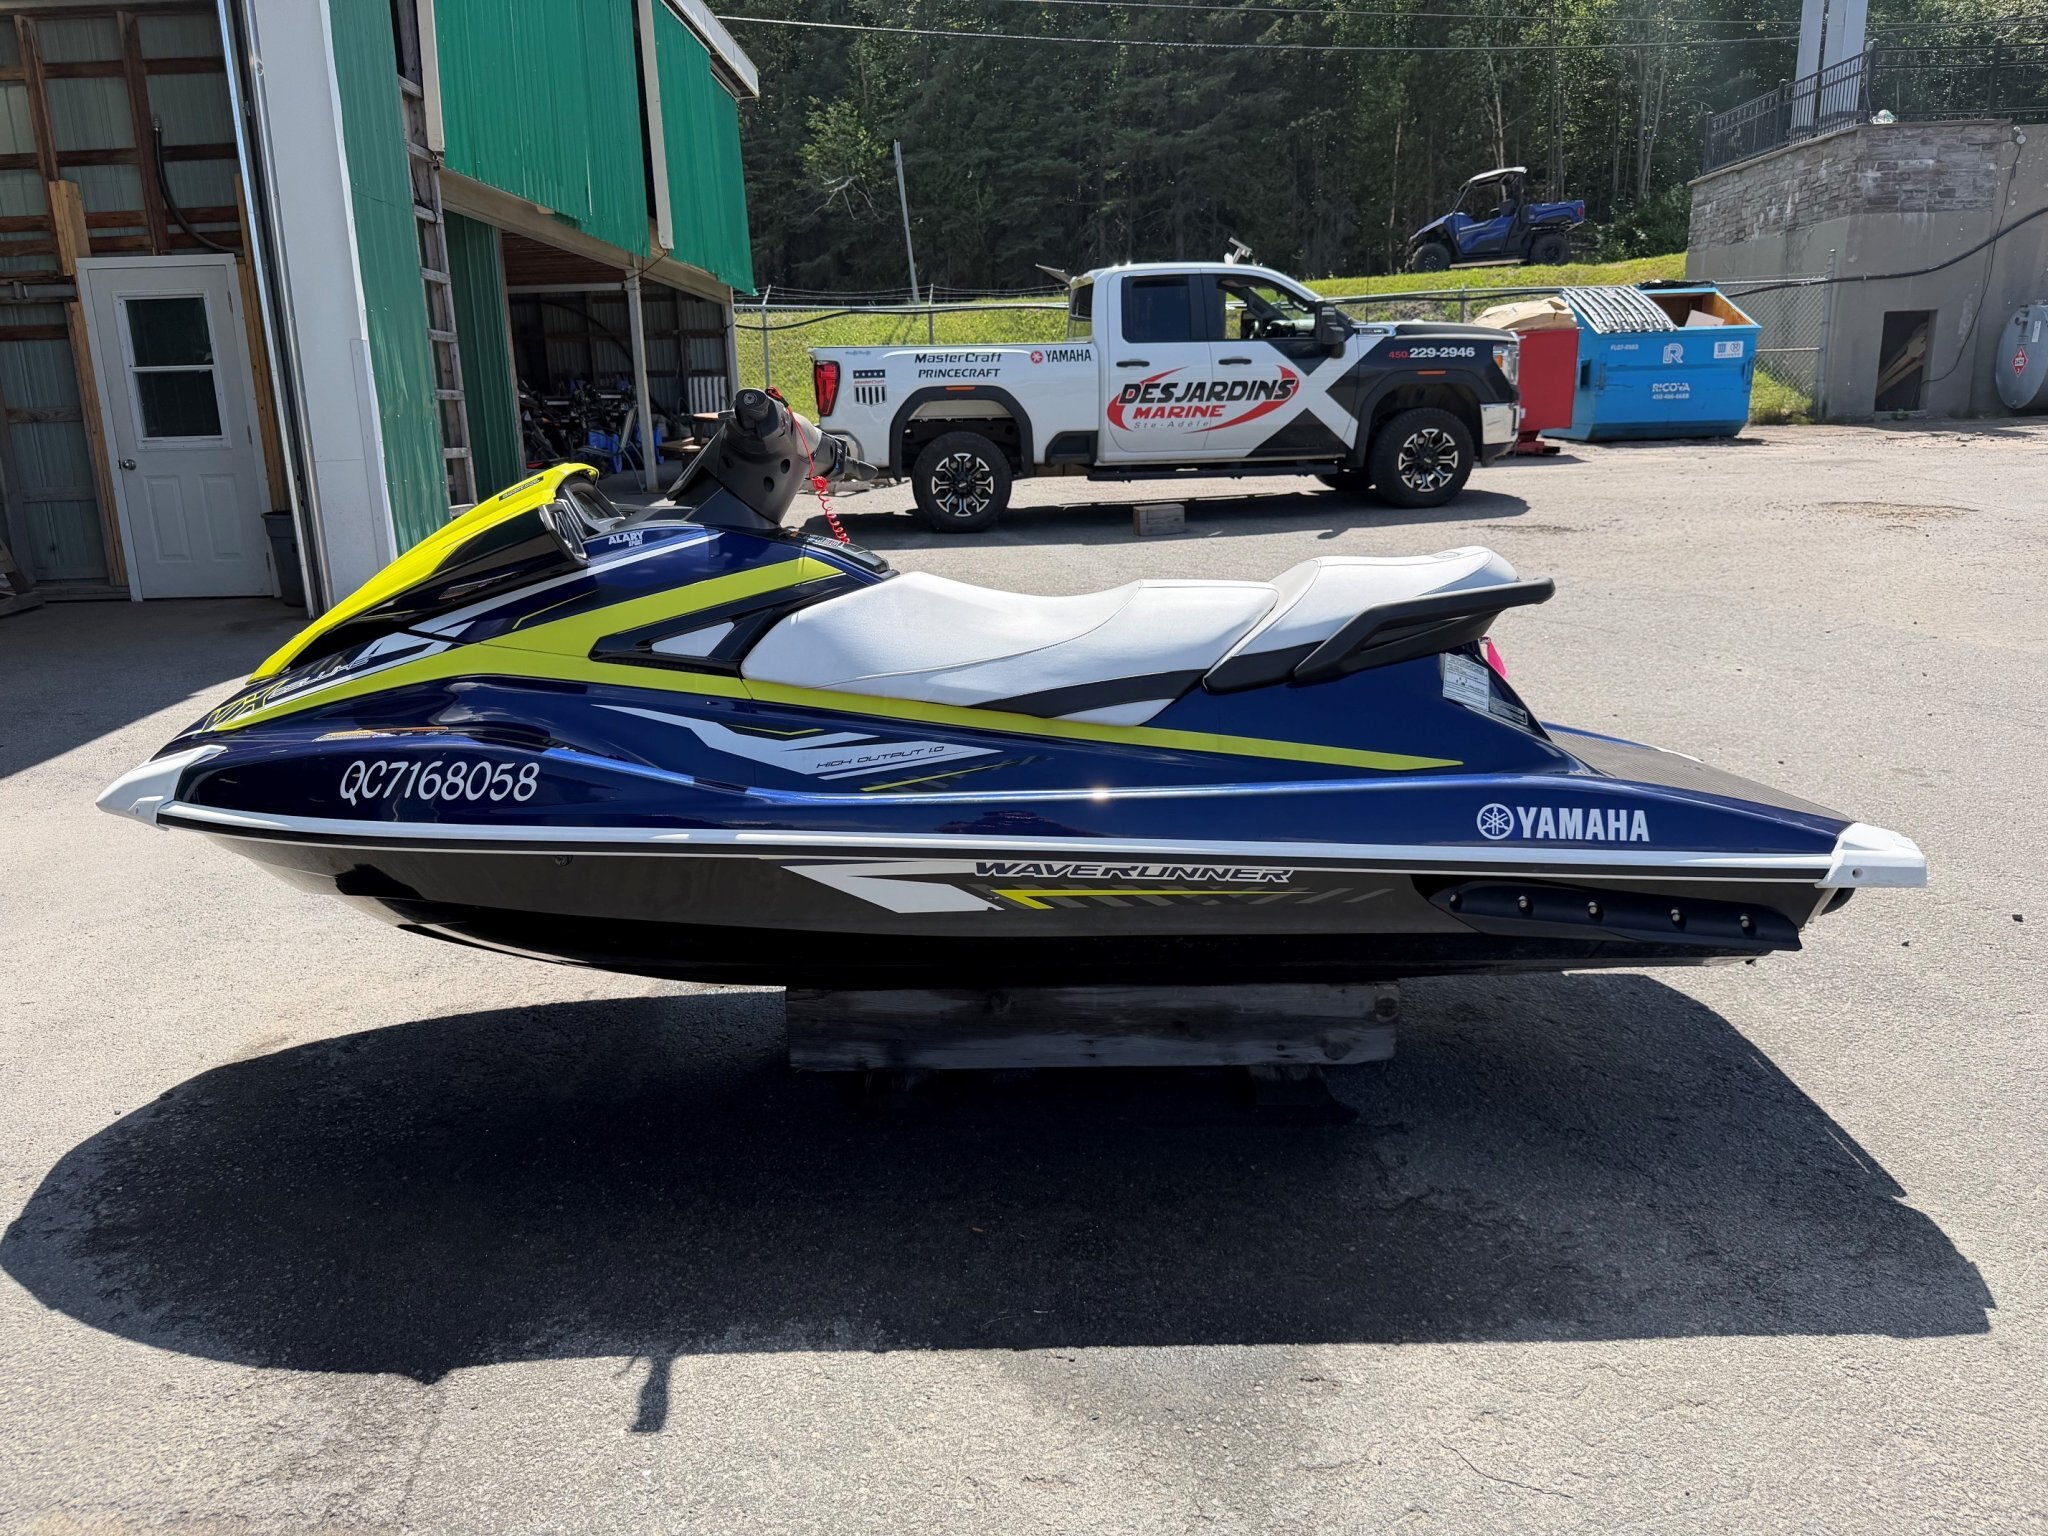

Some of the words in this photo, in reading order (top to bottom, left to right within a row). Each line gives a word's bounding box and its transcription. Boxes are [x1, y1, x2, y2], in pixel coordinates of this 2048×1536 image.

[914, 352, 1002, 363] MasterCraft
[1044, 349, 1091, 362] YAMAHA
[917, 368, 1001, 378] PRINCECRAFT
[1118, 378, 1297, 404] DESJARDINS
[1652, 382, 1690, 392] RICOVA
[1132, 404, 1227, 420] MARINE
[608, 530, 644, 545] ALARY
[816, 758, 853, 769] HIGH
[857, 748, 925, 763] OUTPUT
[340, 759, 540, 806] QC7168058
[1516, 806, 1650, 842] YAMAHA
[974, 862, 1296, 883] WAVERUNNER
